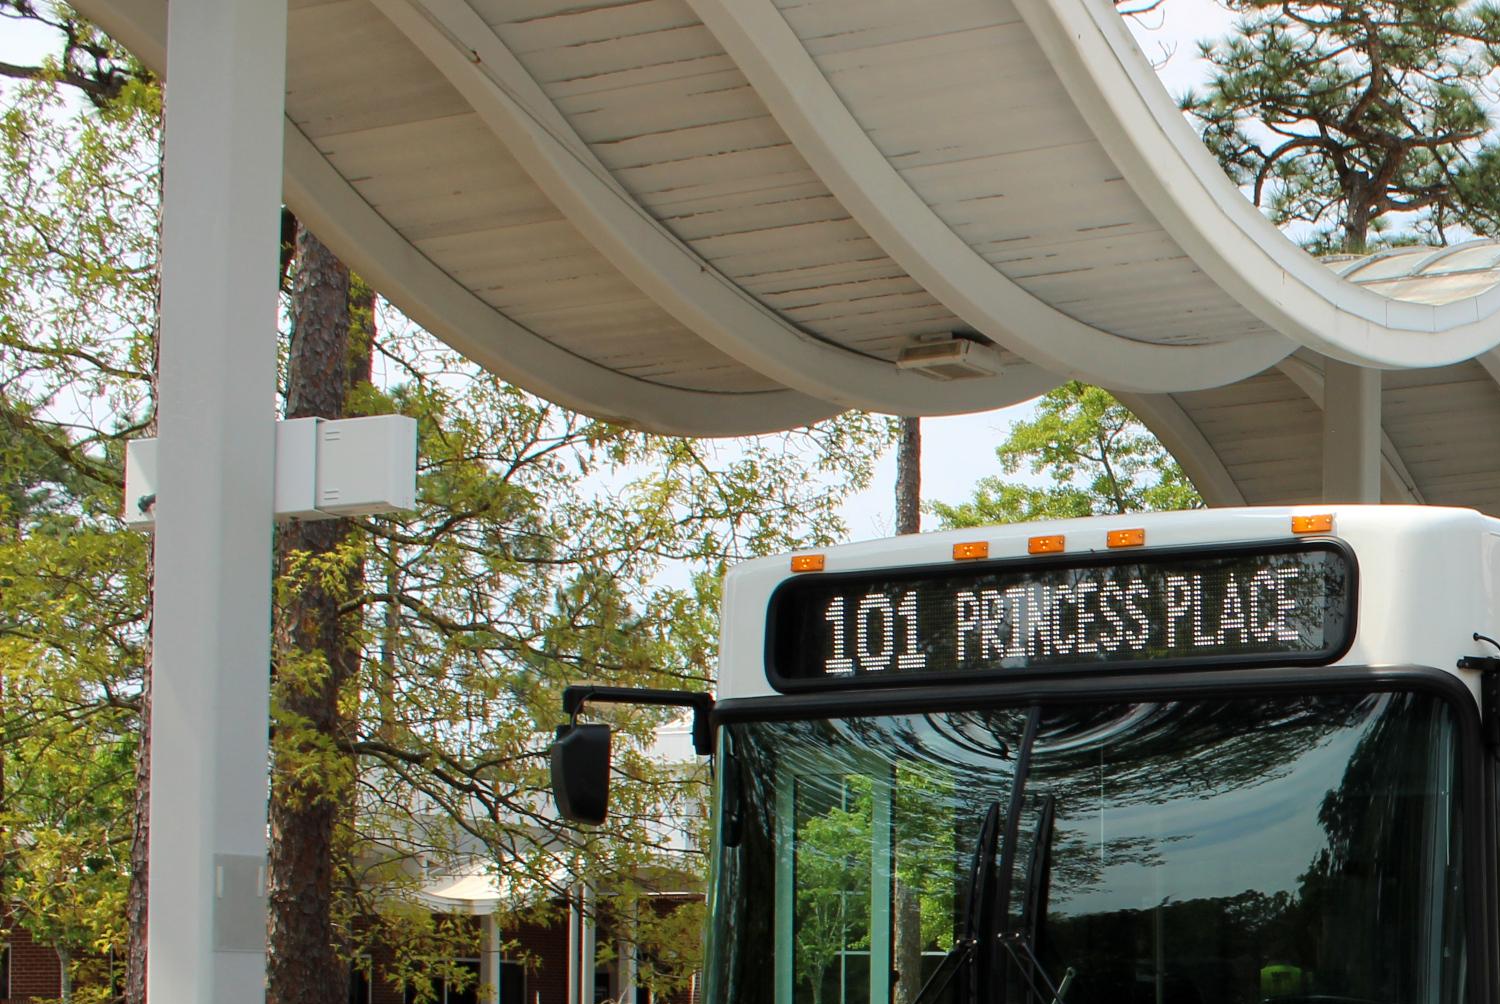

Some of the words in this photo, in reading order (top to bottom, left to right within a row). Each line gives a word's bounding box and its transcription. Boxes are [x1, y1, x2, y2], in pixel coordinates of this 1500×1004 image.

[824, 591, 926, 673] 101
[956, 579, 1150, 661] PRINCESS
[1166, 567, 1301, 648] PLACE
